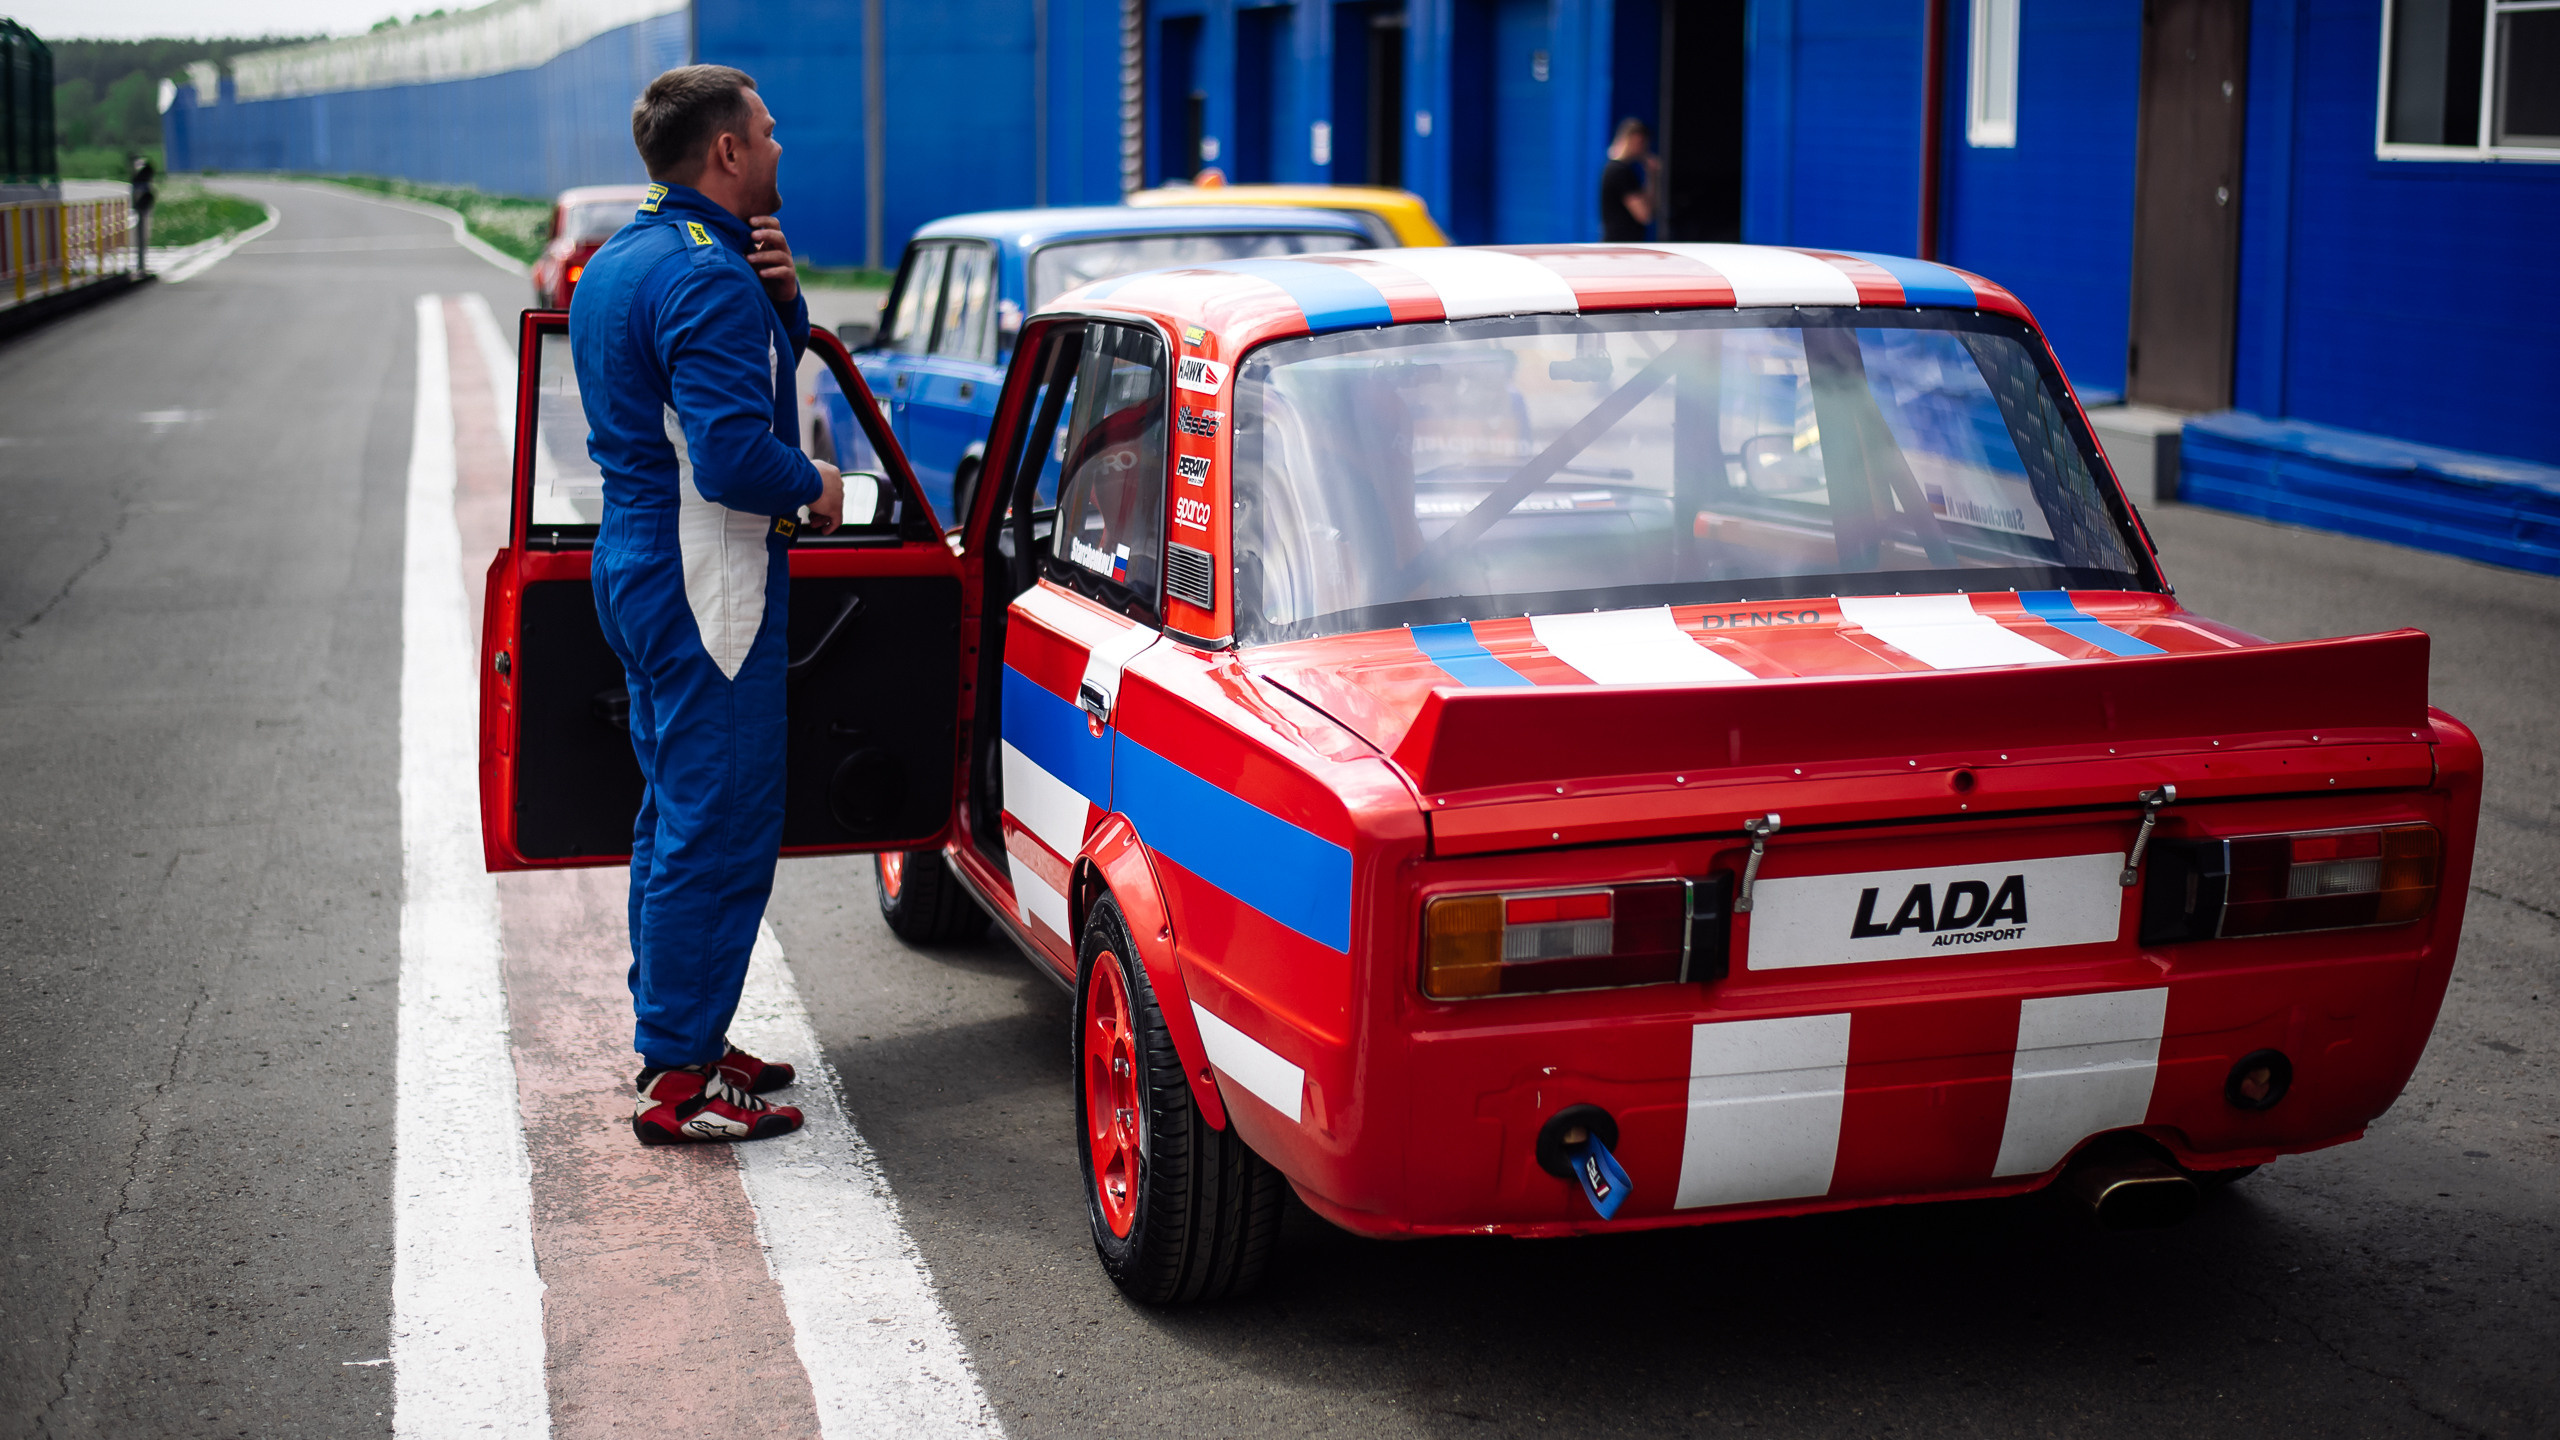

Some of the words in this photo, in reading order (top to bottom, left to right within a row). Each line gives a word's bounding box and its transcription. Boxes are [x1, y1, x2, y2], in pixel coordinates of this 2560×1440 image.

[1178, 359, 1206, 383] HAWK
[1177, 456, 1209, 478] PERAM
[1176, 497, 1211, 527] sparco
[1702, 610, 1820, 629] DENSO
[1850, 874, 2028, 939] LADA
[1931, 927, 2026, 946] AUTOSPORT
